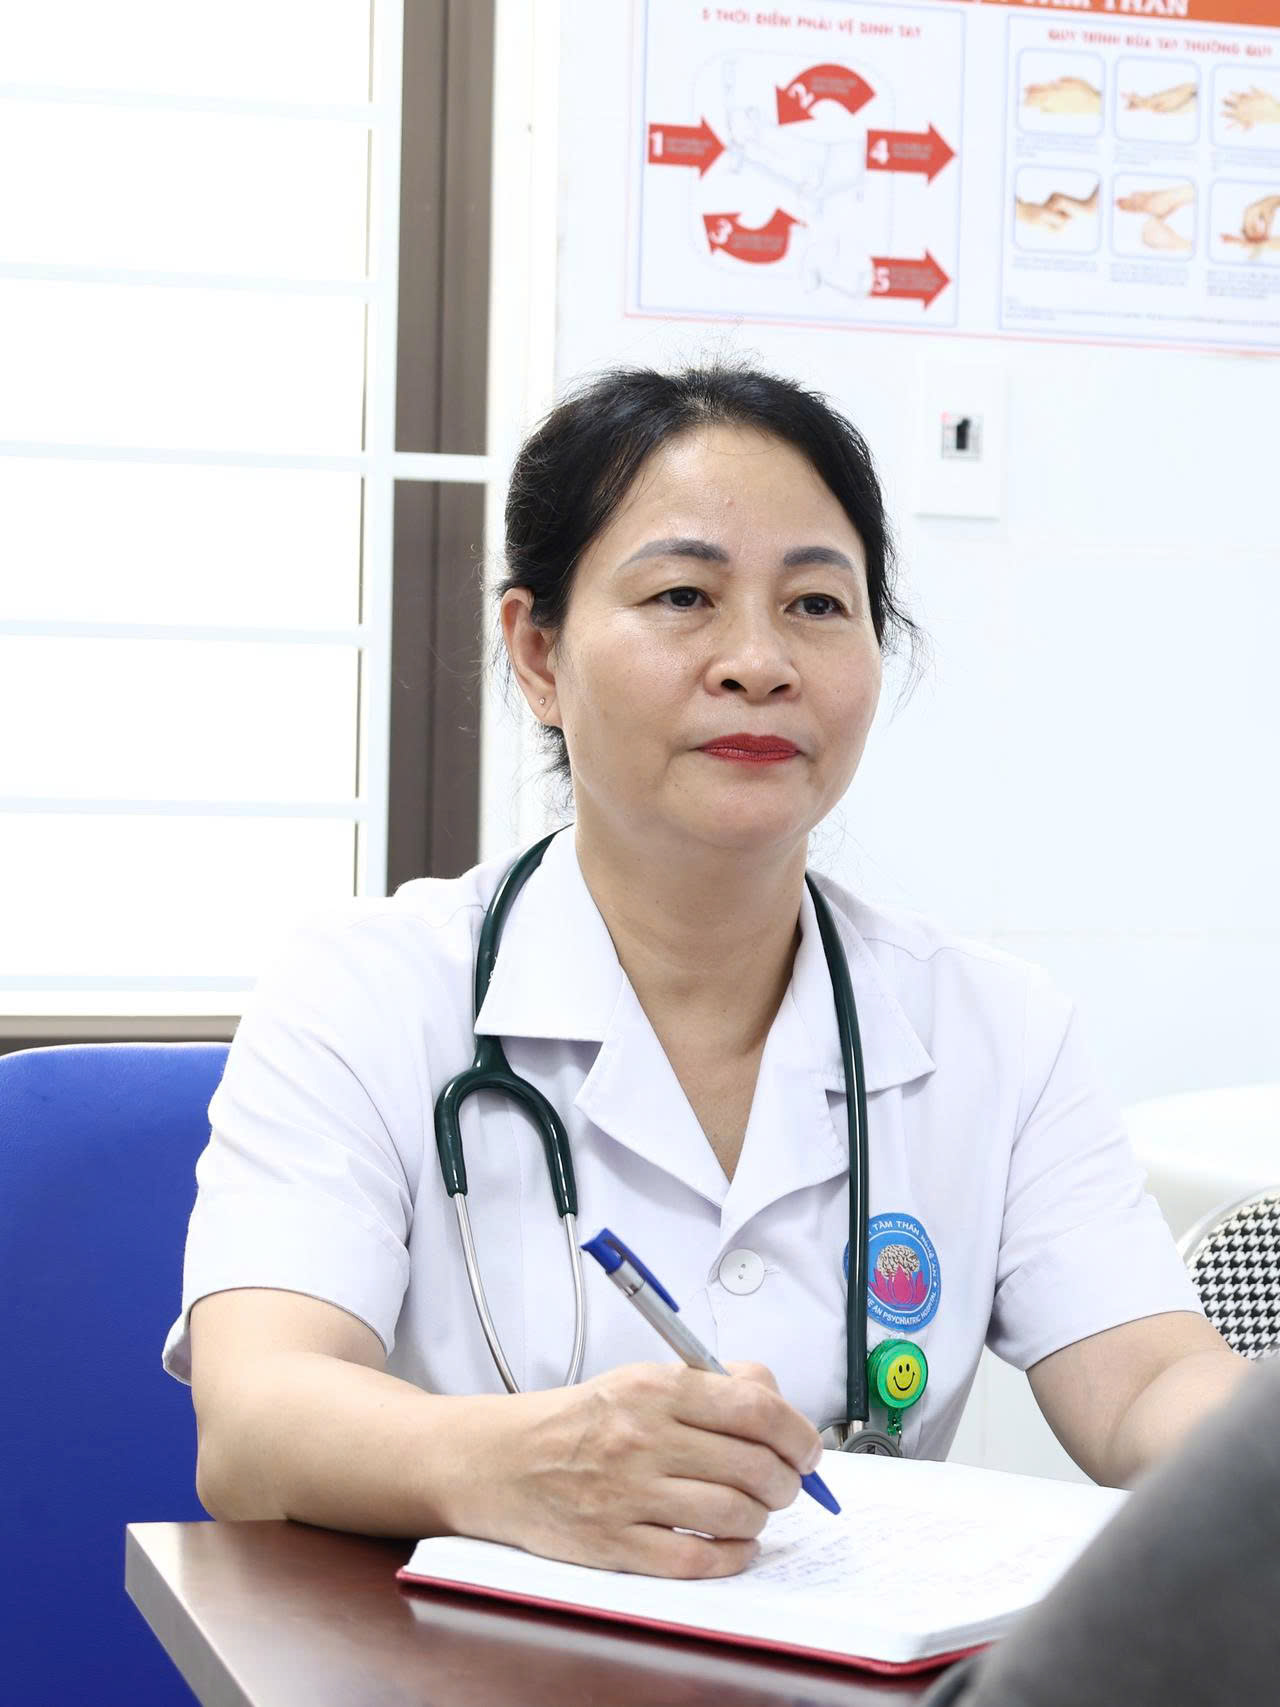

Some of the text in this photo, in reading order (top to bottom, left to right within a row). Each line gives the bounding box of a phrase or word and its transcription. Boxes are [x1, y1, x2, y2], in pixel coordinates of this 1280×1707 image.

[788, 82, 815, 109] 2
[650, 132, 664, 157] 1
[870, 138, 890, 165] 4
[709, 218, 733, 245] 3
[873, 267, 890, 293] 5
[873, 1304, 883, 1315] AN
